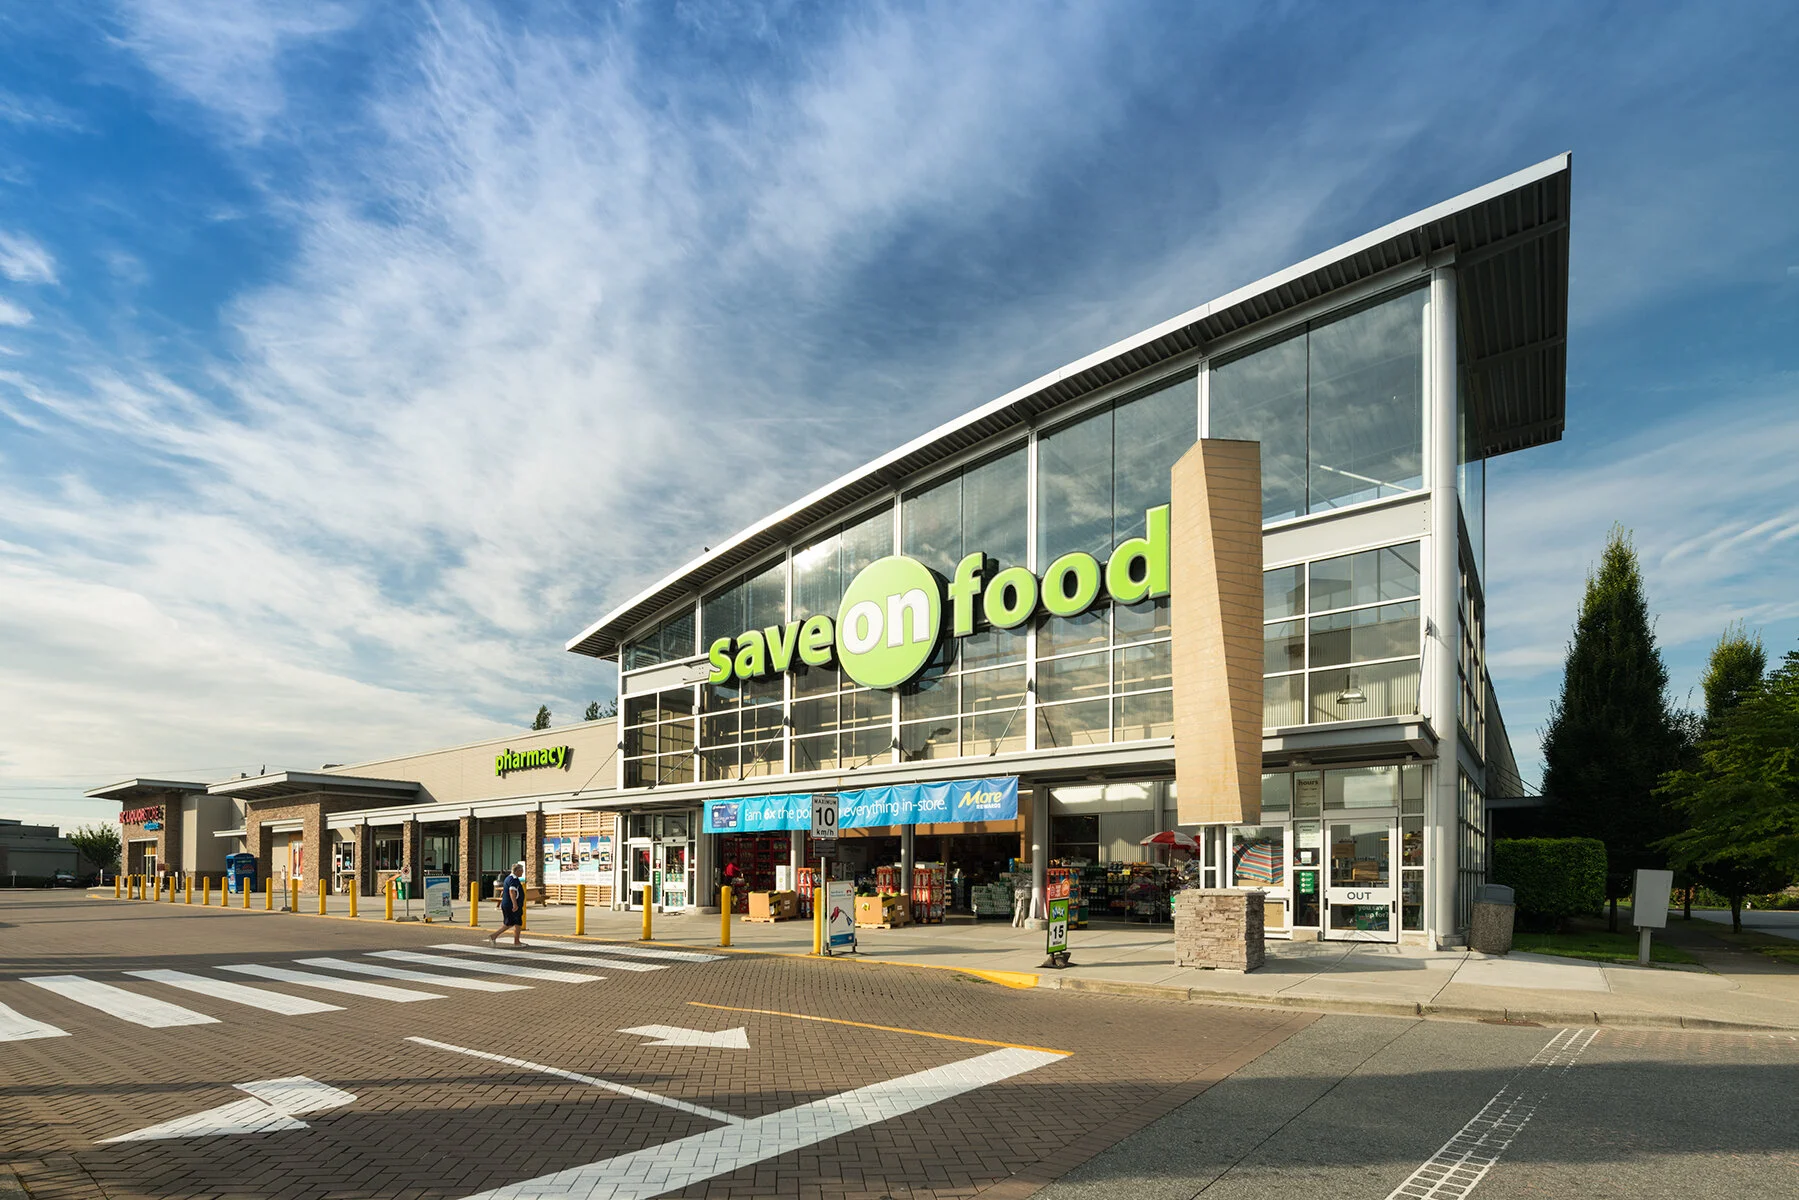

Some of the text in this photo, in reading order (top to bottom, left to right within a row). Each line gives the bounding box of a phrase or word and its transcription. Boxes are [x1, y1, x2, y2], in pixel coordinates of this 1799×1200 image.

[708, 614, 835, 686] save
[841, 587, 931, 655] on
[495, 745, 567, 776] pharmacy
[958, 790, 1002, 808] More
[744, 808, 762, 822] Earn
[764, 807, 776, 820] 6x
[777, 806, 794, 819] the
[796, 806, 812, 822] poi
[843, 800, 899, 818] everything
[902, 798, 947, 812] in-store.
[815, 806, 835, 827] 10
[1347, 891, 1372, 900] OUT
[1365, 911, 1374, 919] up
[1053, 925, 1064, 939] 15
